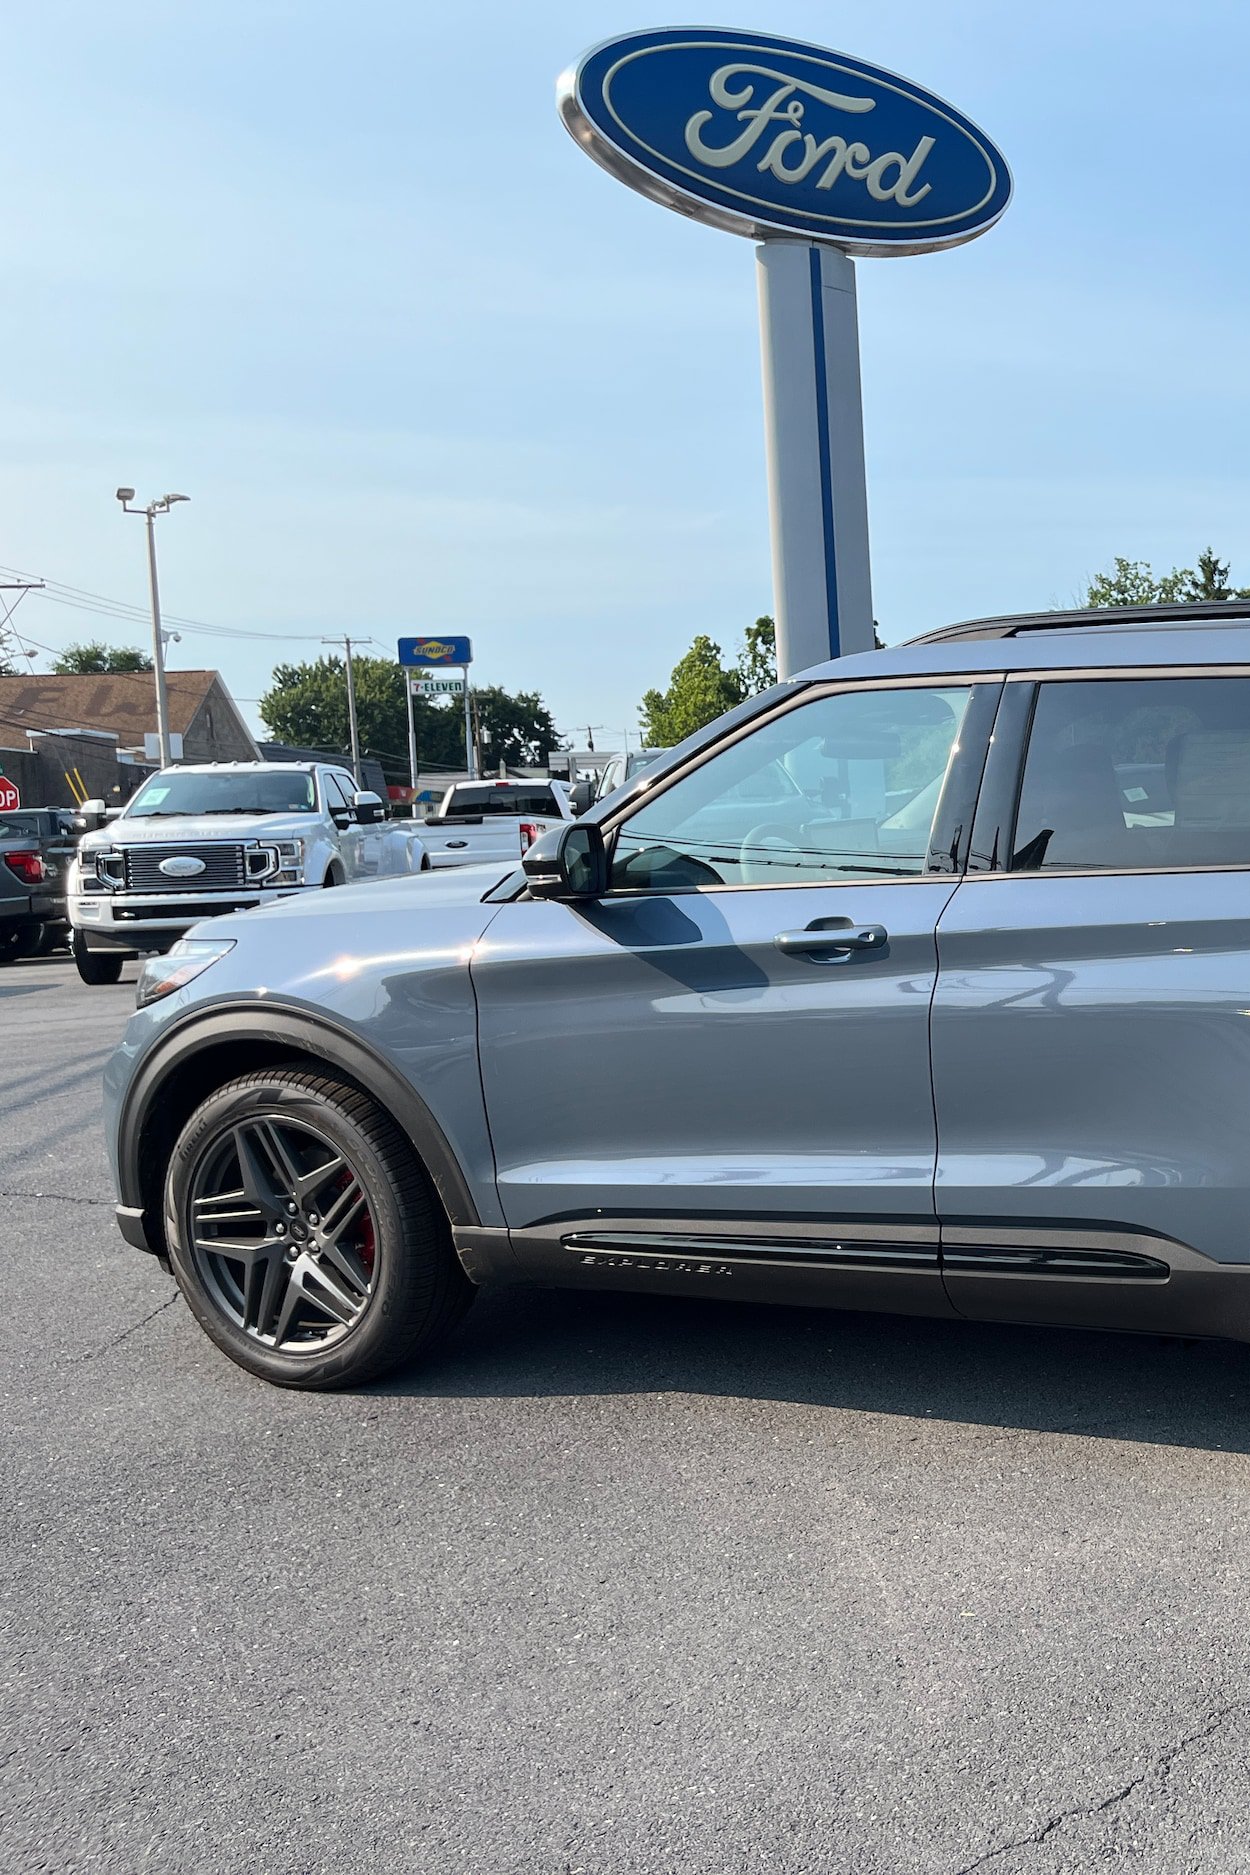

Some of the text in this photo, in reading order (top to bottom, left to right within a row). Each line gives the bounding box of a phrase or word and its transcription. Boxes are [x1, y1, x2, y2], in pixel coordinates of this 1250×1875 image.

[685, 63, 936, 207] Ford
[414, 645, 455, 655] SUNOCO
[580, 1256, 733, 1275] EXPLORER
